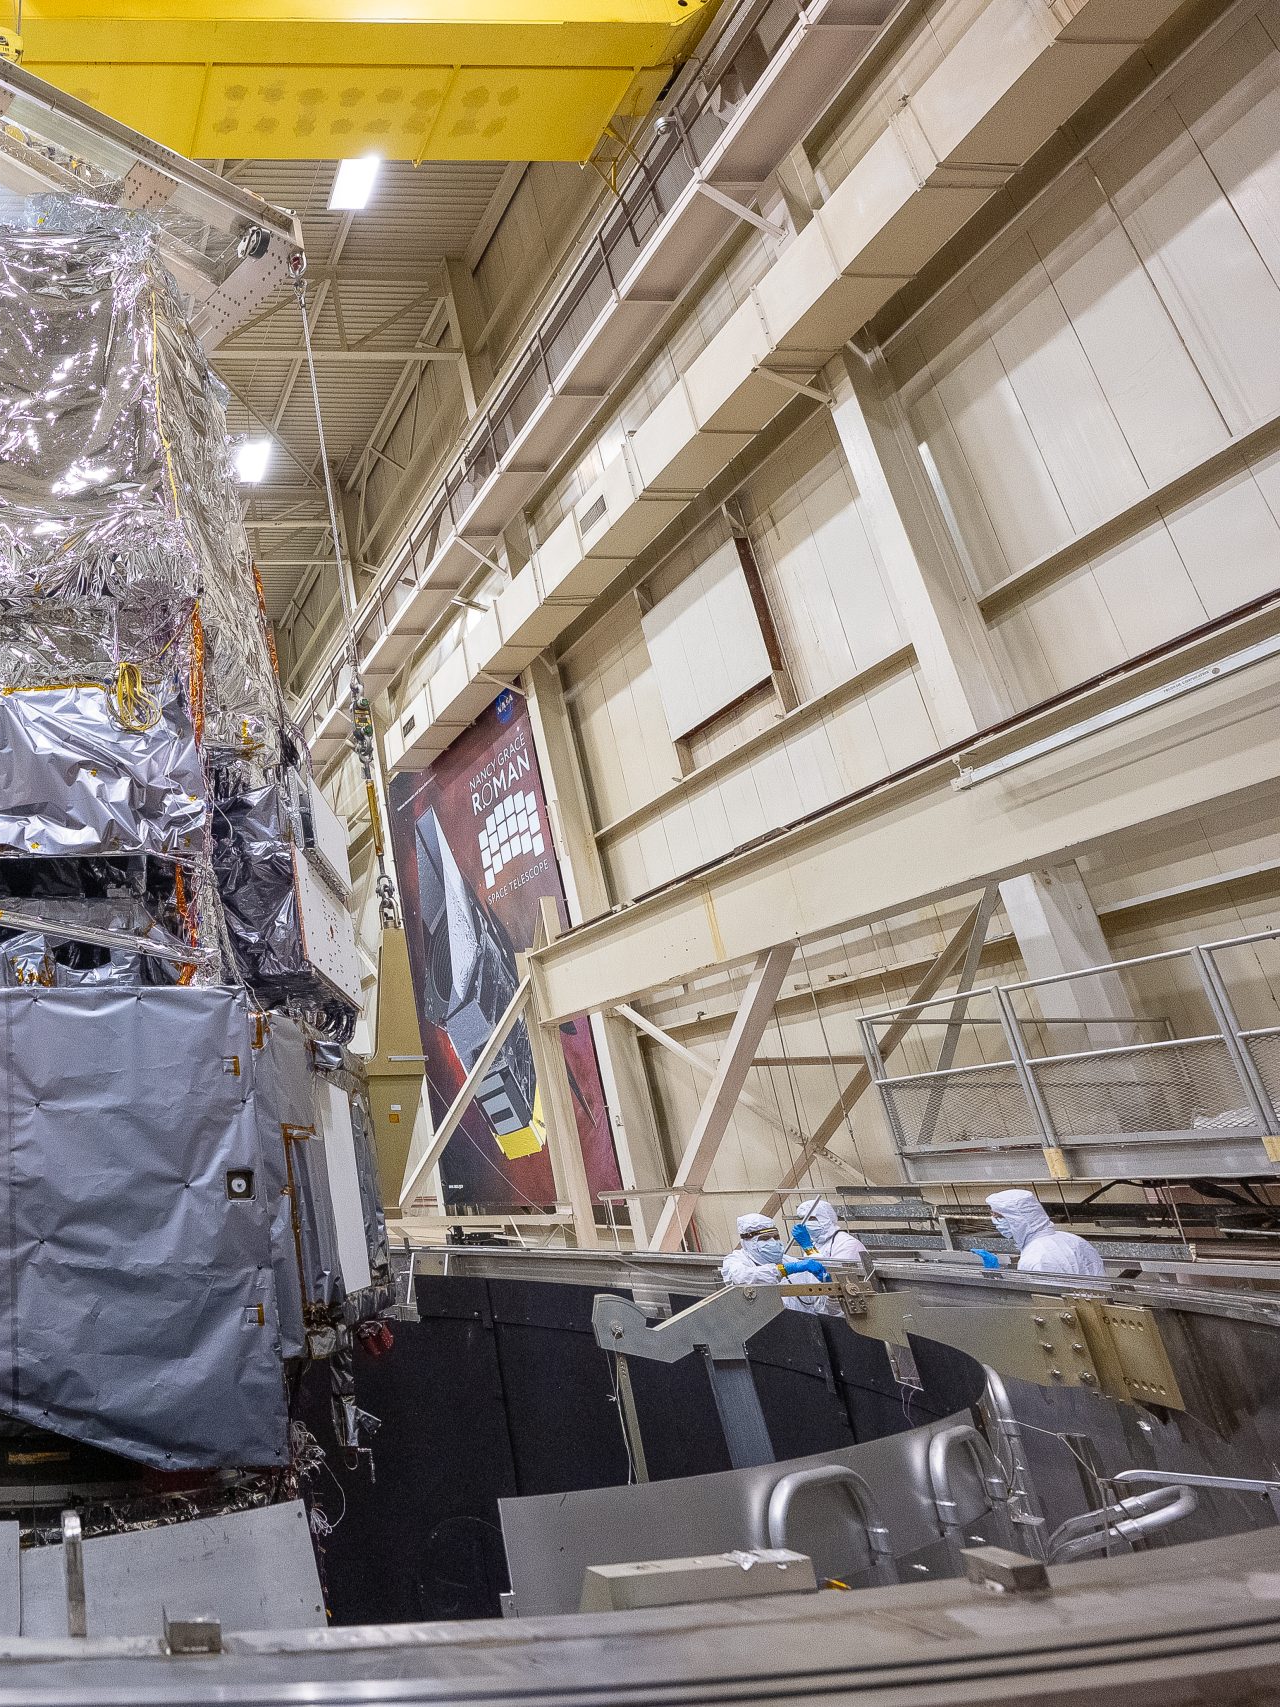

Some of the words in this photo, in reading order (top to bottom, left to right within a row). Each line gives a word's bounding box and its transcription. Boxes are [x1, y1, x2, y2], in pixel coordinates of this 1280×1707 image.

[497, 693, 514, 715] NASA
[469, 758, 496, 792] NANCY
[497, 732, 526, 766] GRACE
[488, 885, 508, 905] SPACE
[509, 859, 549, 890] TELESCOPE
